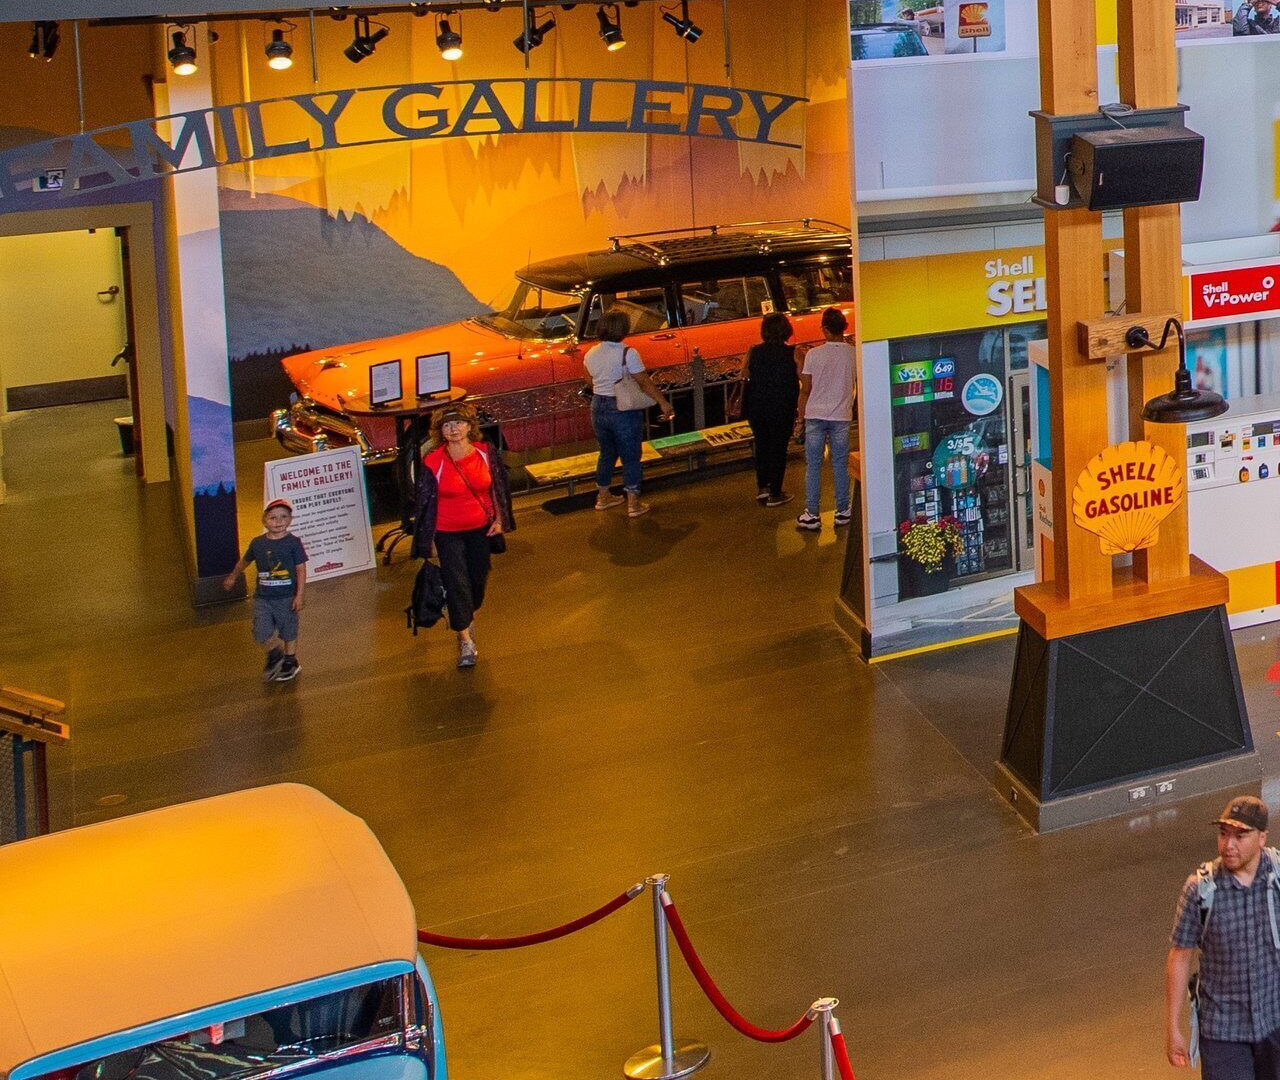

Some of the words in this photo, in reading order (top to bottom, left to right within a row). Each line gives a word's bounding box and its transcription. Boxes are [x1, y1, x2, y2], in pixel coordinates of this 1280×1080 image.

[959, 26, 990, 36] Shell
[382, 78, 809, 147] GALLERY
[984, 255, 1033, 278] Shell
[1202, 282, 1229, 295] Shell
[1203, 289, 1270, 308] V-Power
[280, 466, 320, 481] WELCOME
[323, 463, 334, 473] TO
[336, 460, 351, 470] THE
[1097, 461, 1156, 488] SHELL
[281, 479, 311, 492] FAMILY
[314, 471, 353, 485] GALLERY!
[1085, 487, 1174, 520] GASOLINE
